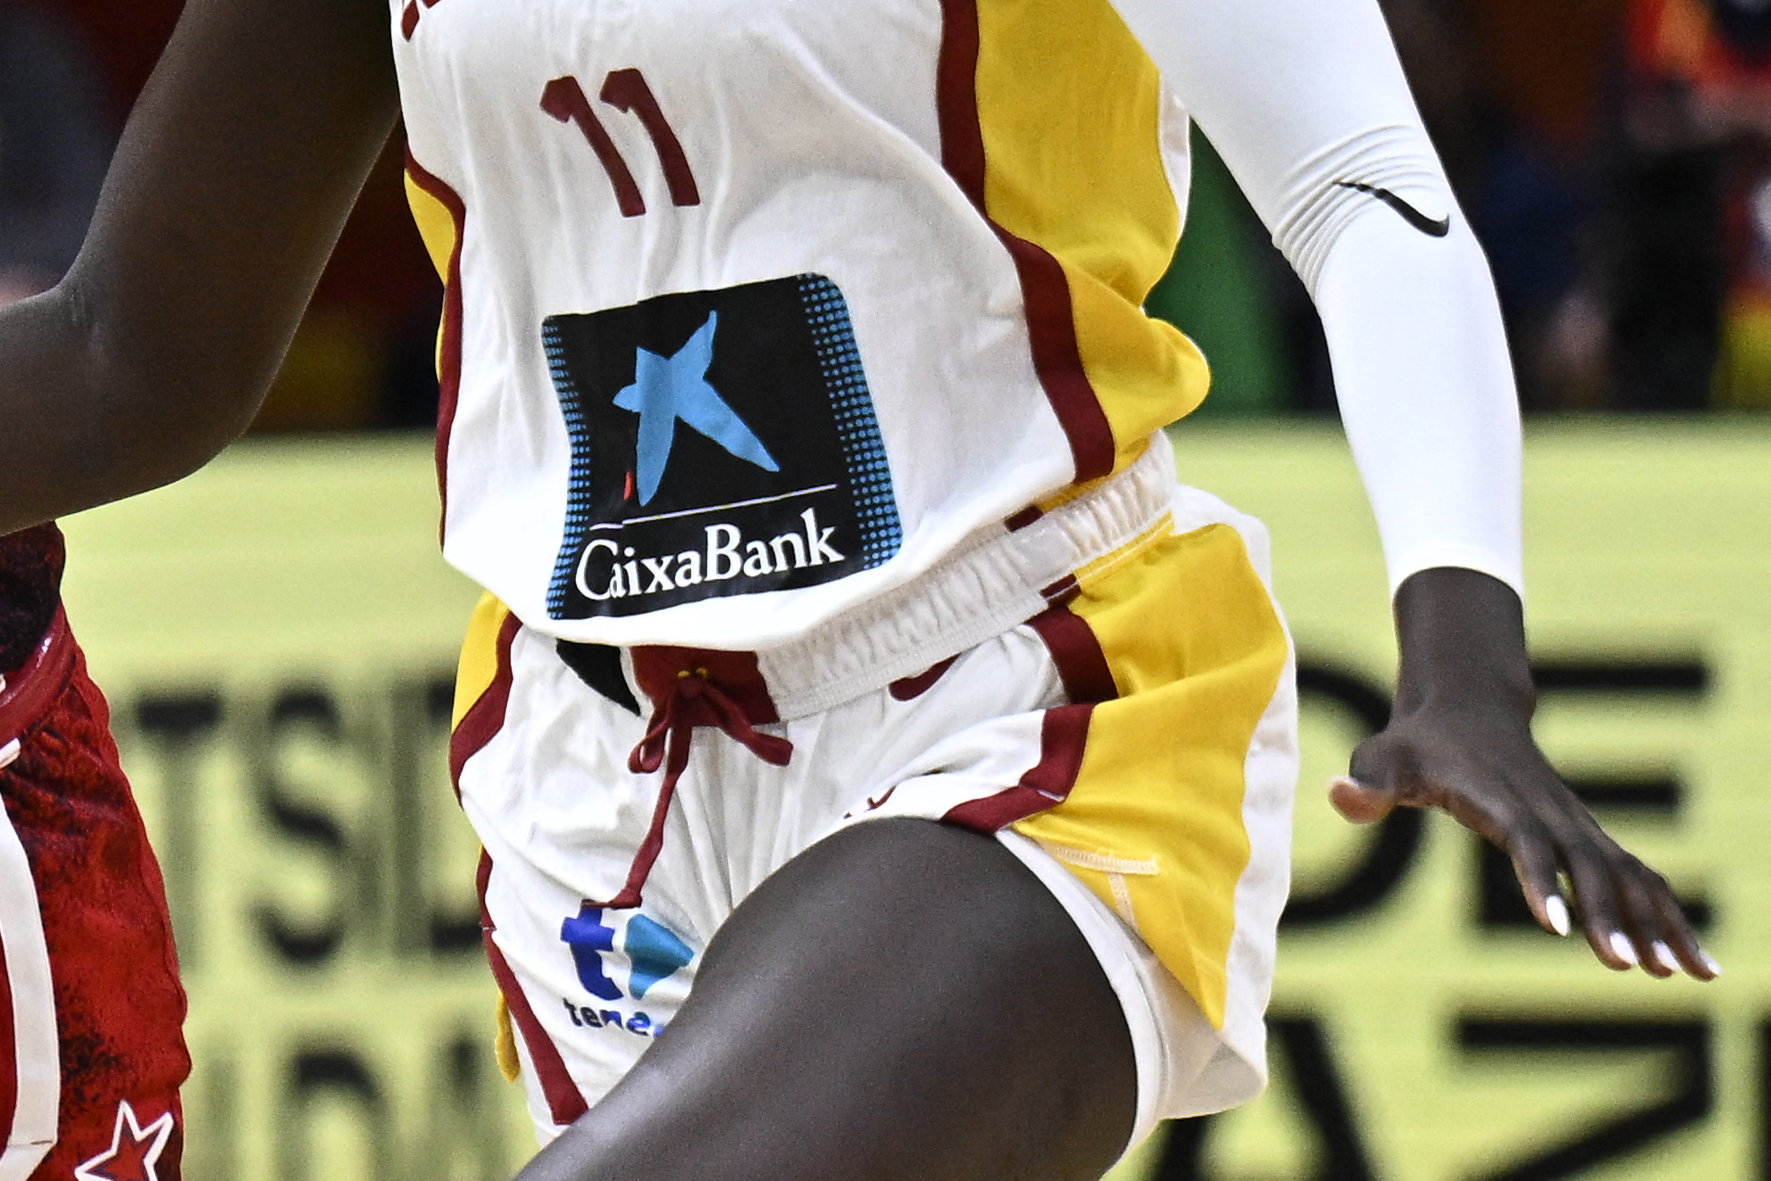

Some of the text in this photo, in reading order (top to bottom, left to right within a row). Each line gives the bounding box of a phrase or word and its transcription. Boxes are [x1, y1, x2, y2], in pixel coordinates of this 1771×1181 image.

[539, 66, 701, 218] 11
[574, 507, 846, 603] CaixaBank
[562, 996, 666, 1038] tene
